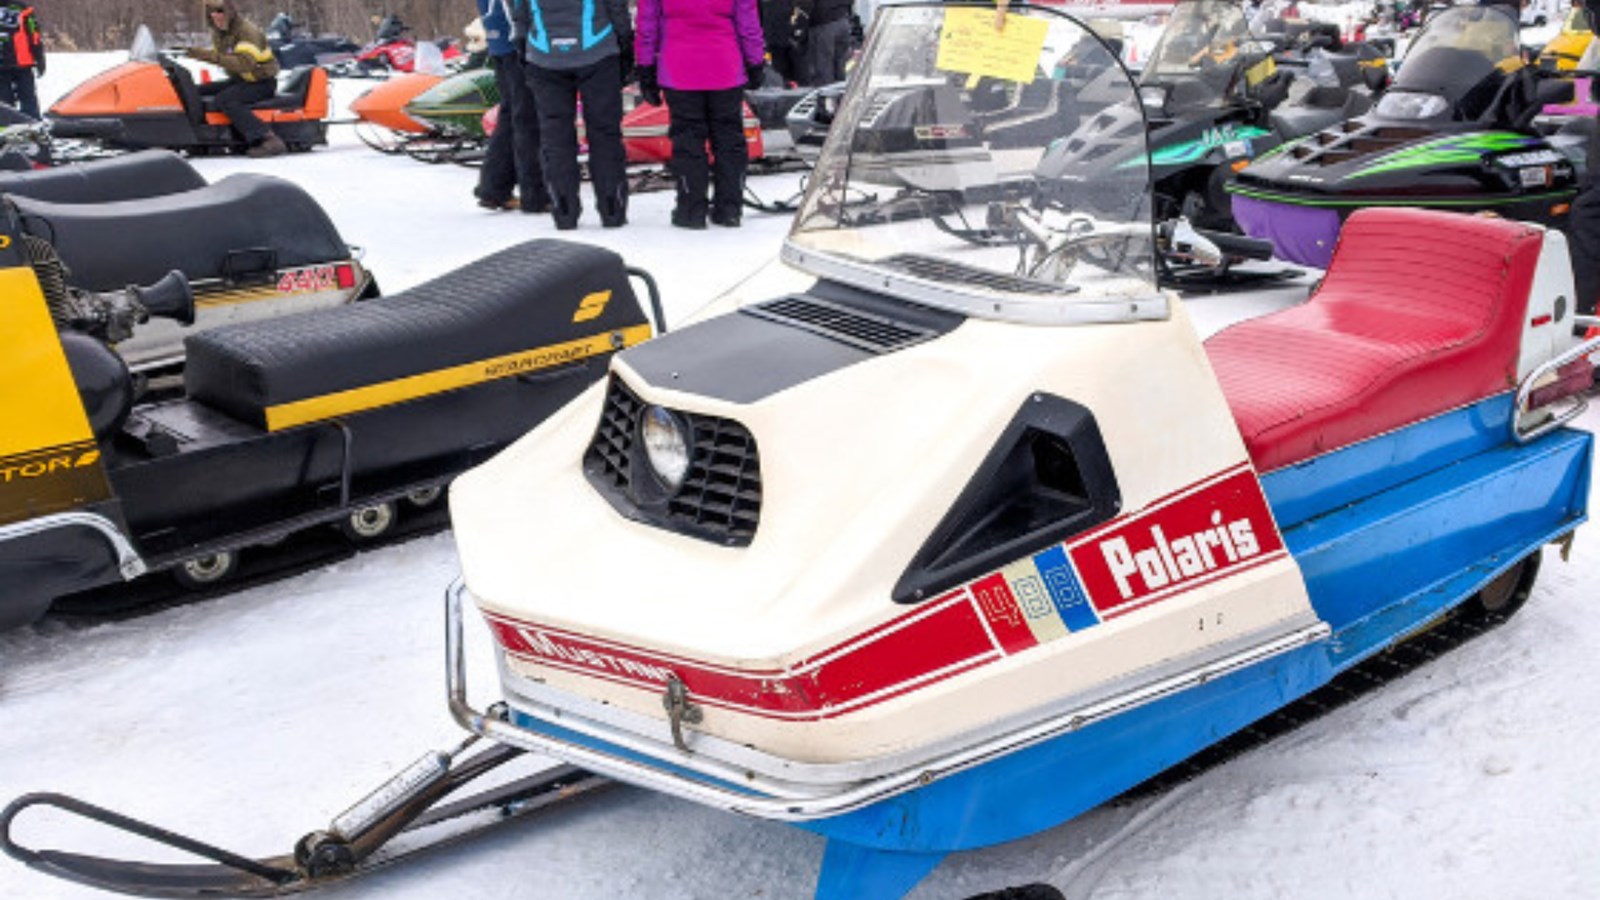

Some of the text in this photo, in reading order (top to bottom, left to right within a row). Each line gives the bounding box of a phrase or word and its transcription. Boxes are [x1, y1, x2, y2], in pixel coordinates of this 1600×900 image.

[276, 264, 335, 293] 440
[1100, 509, 1260, 599] Polaris
[979, 564, 1084, 628] 488
